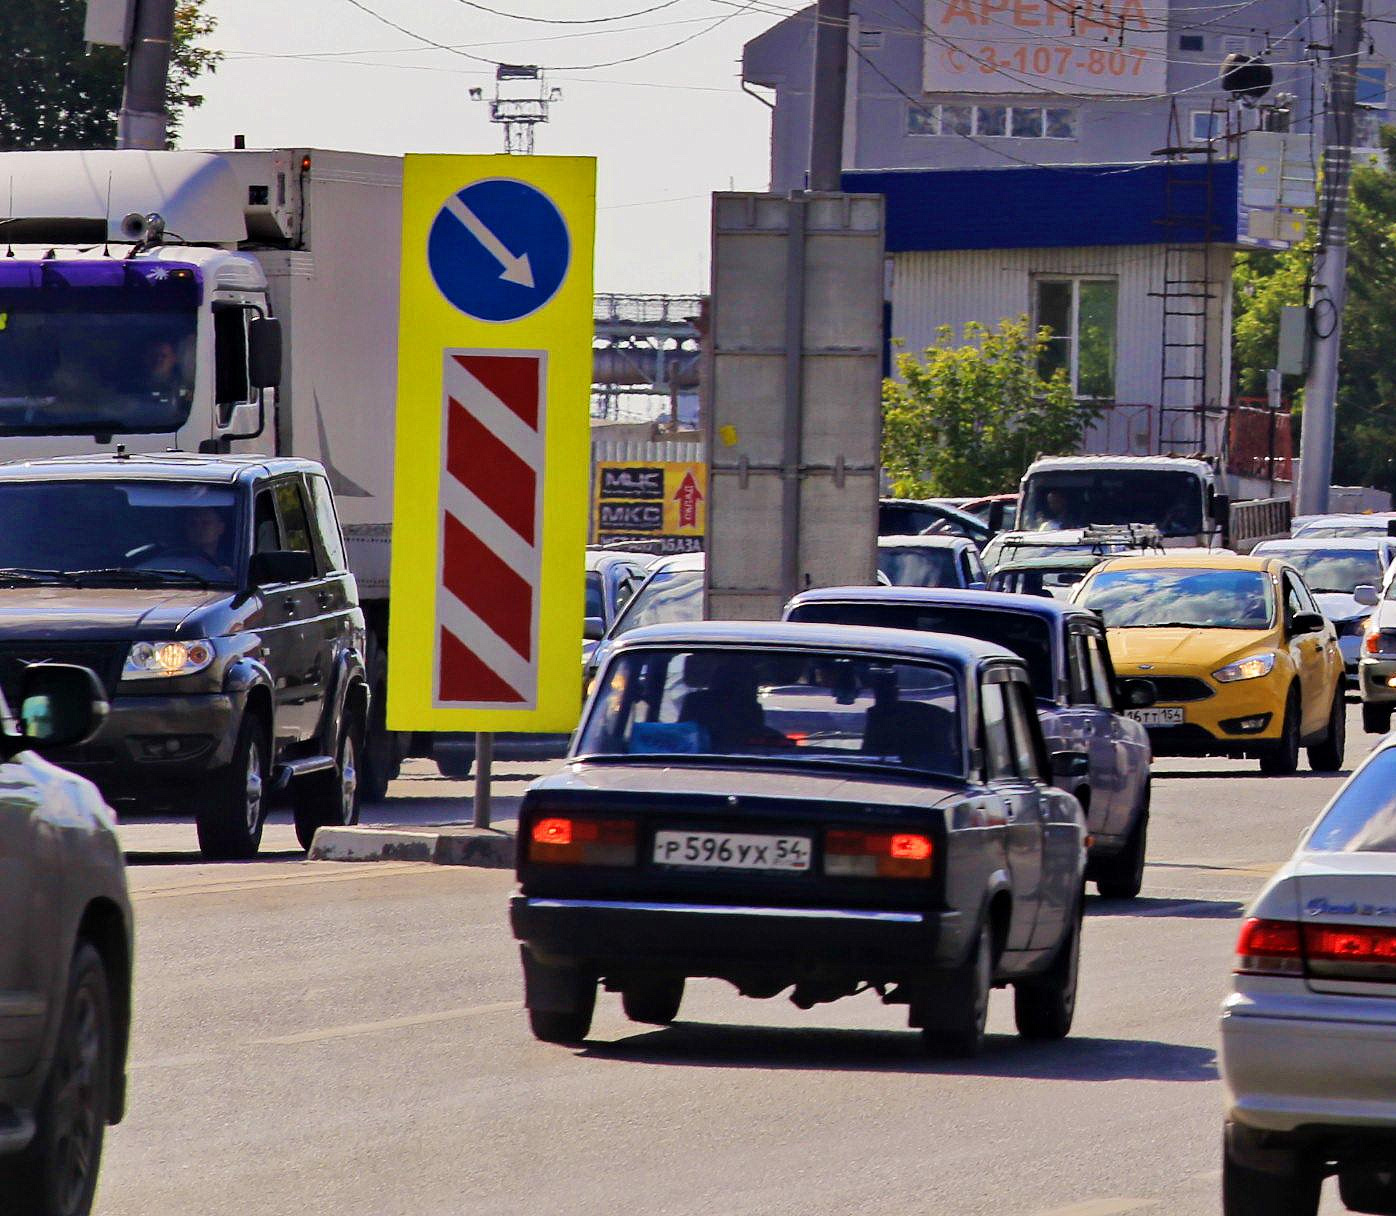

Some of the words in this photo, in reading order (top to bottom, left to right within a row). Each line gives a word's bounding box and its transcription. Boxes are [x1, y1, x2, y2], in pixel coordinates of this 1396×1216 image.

[979, 45, 1148, 76] 3-107-807
[665, 836, 769, 865] Р596УХ
[775, 839, 803, 859] 54
